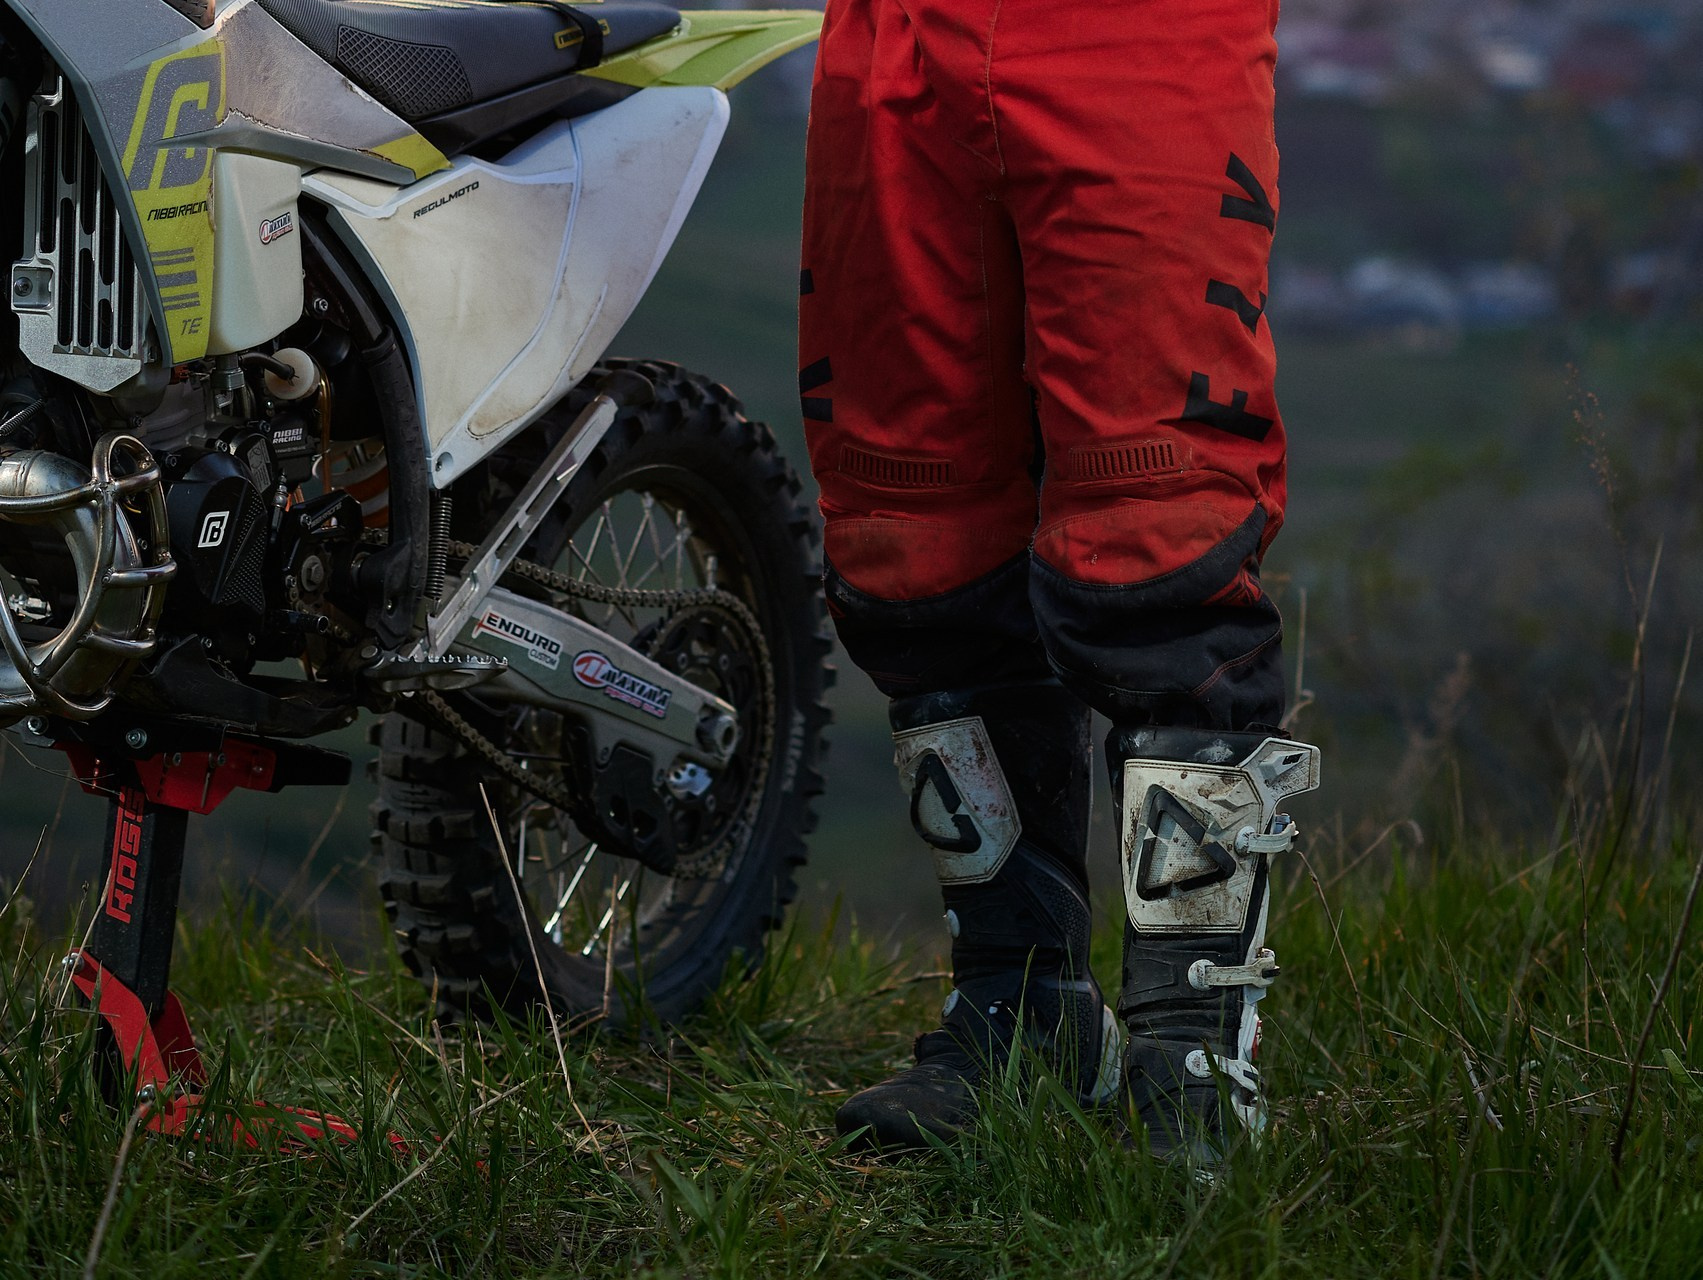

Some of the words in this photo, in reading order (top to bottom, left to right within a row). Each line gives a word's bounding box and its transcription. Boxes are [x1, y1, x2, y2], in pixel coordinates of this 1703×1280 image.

[413, 181, 480, 219] REGULMOTO
[181, 317, 202, 335] TE
[272, 435, 302, 444] RACING
[273, 428, 303, 439] NIBBI
[486, 612, 561, 655] ENDURO
[529, 649, 557, 667] CUSTOM
[600, 669, 671, 709] MAXIMA
